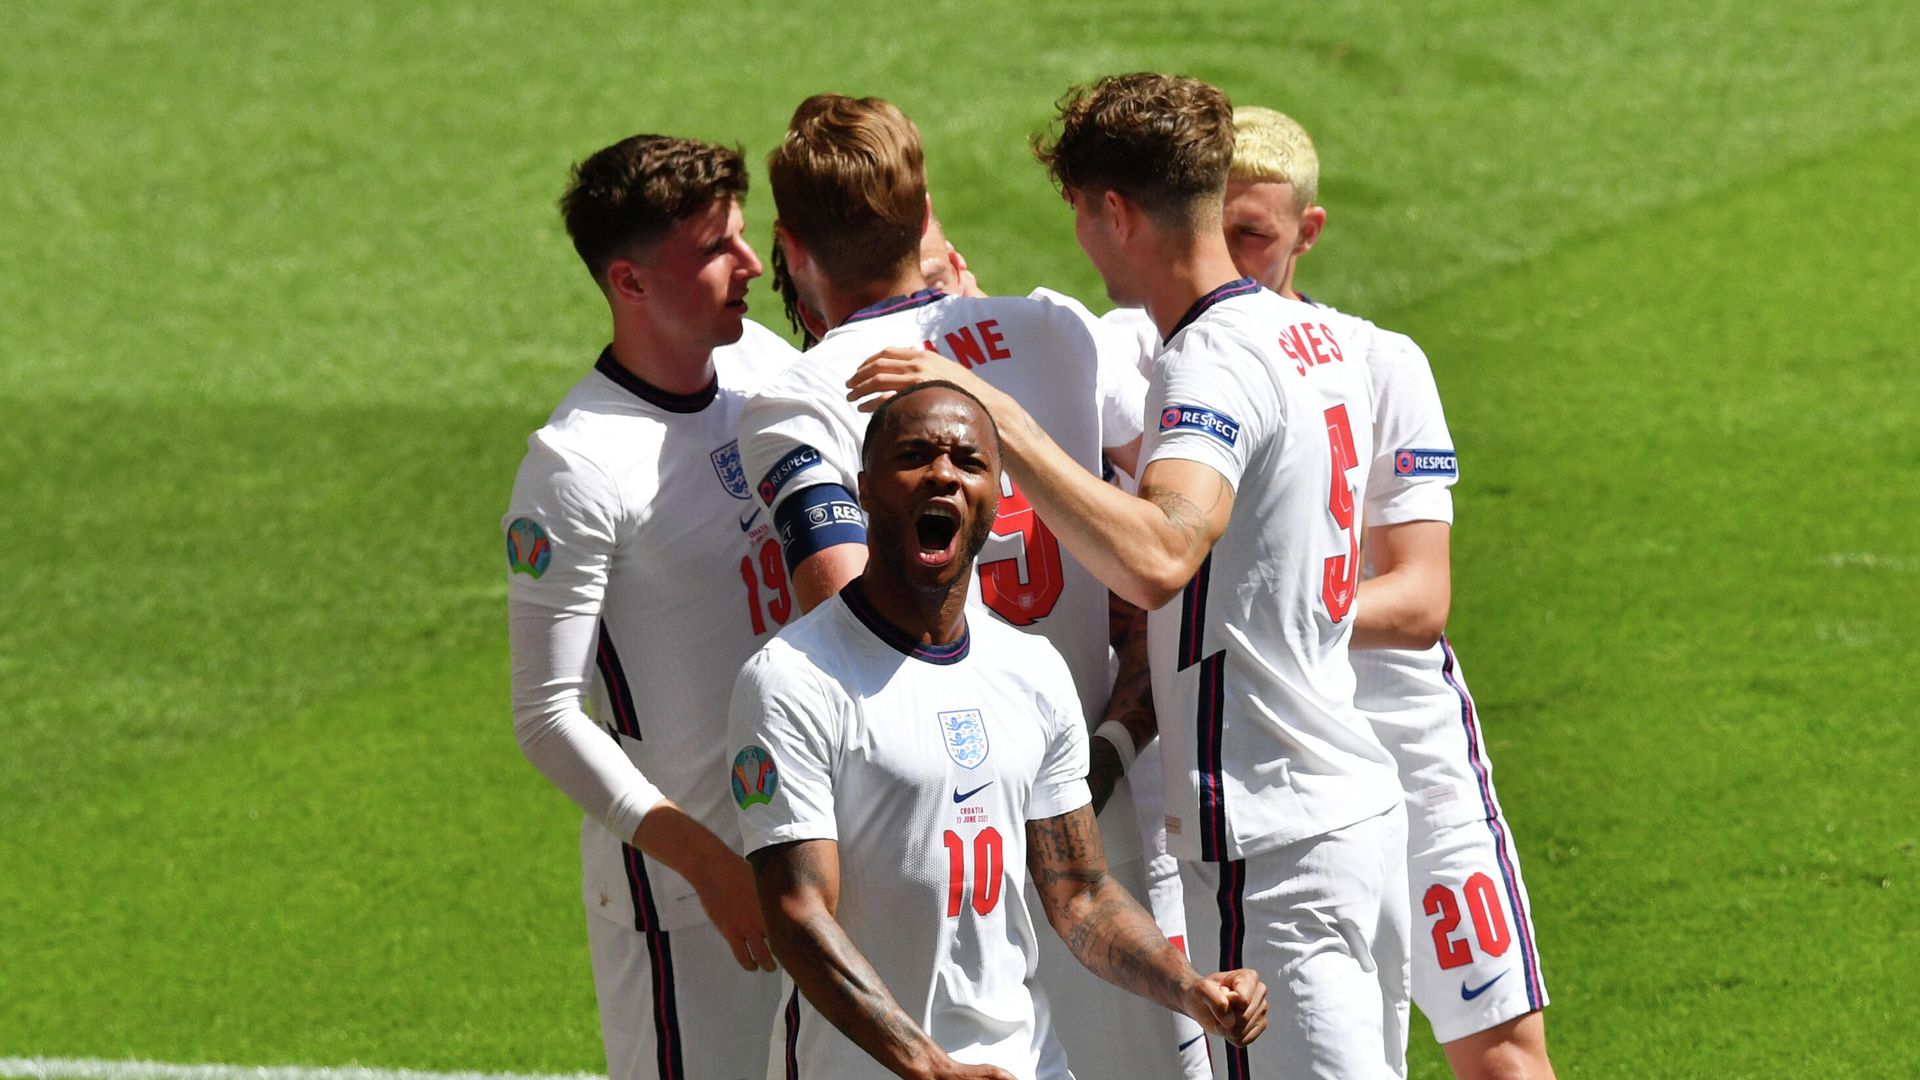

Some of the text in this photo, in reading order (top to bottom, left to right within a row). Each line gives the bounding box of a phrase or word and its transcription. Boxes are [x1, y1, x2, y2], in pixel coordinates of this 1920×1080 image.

[924, 319, 1011, 369] NE
[770, 449, 819, 485] RESPECT
[1182, 411, 1237, 440] RESPECT
[1416, 456, 1456, 469] RESPECT
[979, 470, 1064, 626] 9
[1323, 404, 1359, 624] 5
[741, 538, 791, 635] 19
[943, 826, 1003, 917] 10
[1423, 872, 1511, 970] 20
